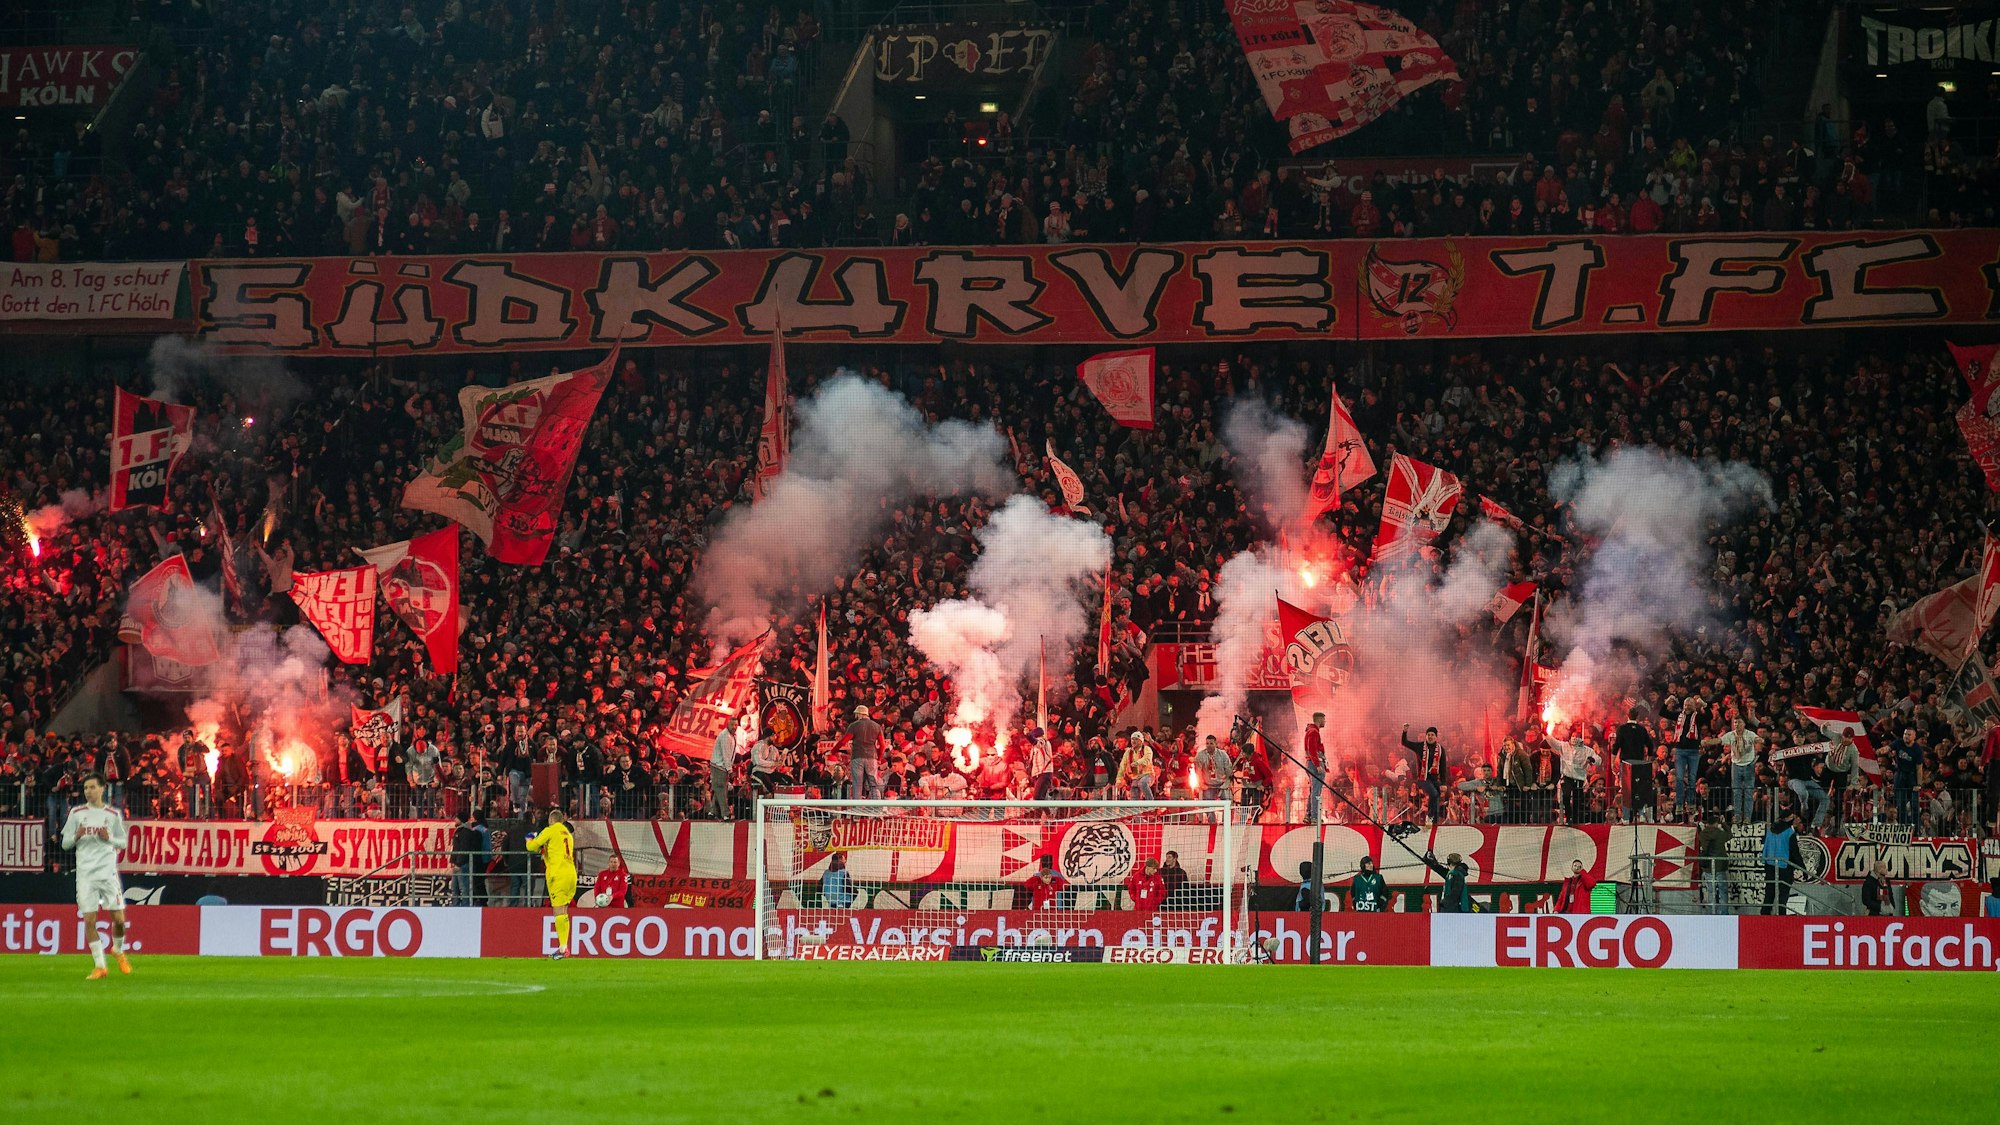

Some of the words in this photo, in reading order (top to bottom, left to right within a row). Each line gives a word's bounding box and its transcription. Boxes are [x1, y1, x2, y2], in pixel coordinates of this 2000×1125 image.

[1861, 16, 2000, 66] TROIK
[20, 81, 95, 106] KÖLN
[11, 268, 43, 288] Am
[51, 269, 67, 288] 8.
[73, 267, 106, 291] Tag
[113, 267, 171, 286] schuf
[1397, 272, 1431, 304] 12
[46, 298, 79, 313] den
[127, 291, 170, 312] Köln
[764, 685, 804, 705] JUNGE
[329, 826, 456, 869] SYNDIKA
[708, 896, 744, 909] 1983
[260, 907, 423, 957] ERGO
[542, 914, 669, 956] ERGO
[1495, 916, 1673, 969] ERGO
[800, 944, 951, 961] FLYERALARM
[1003, 949, 1073, 963] freenet
[1110, 948, 1175, 964] ERGO
